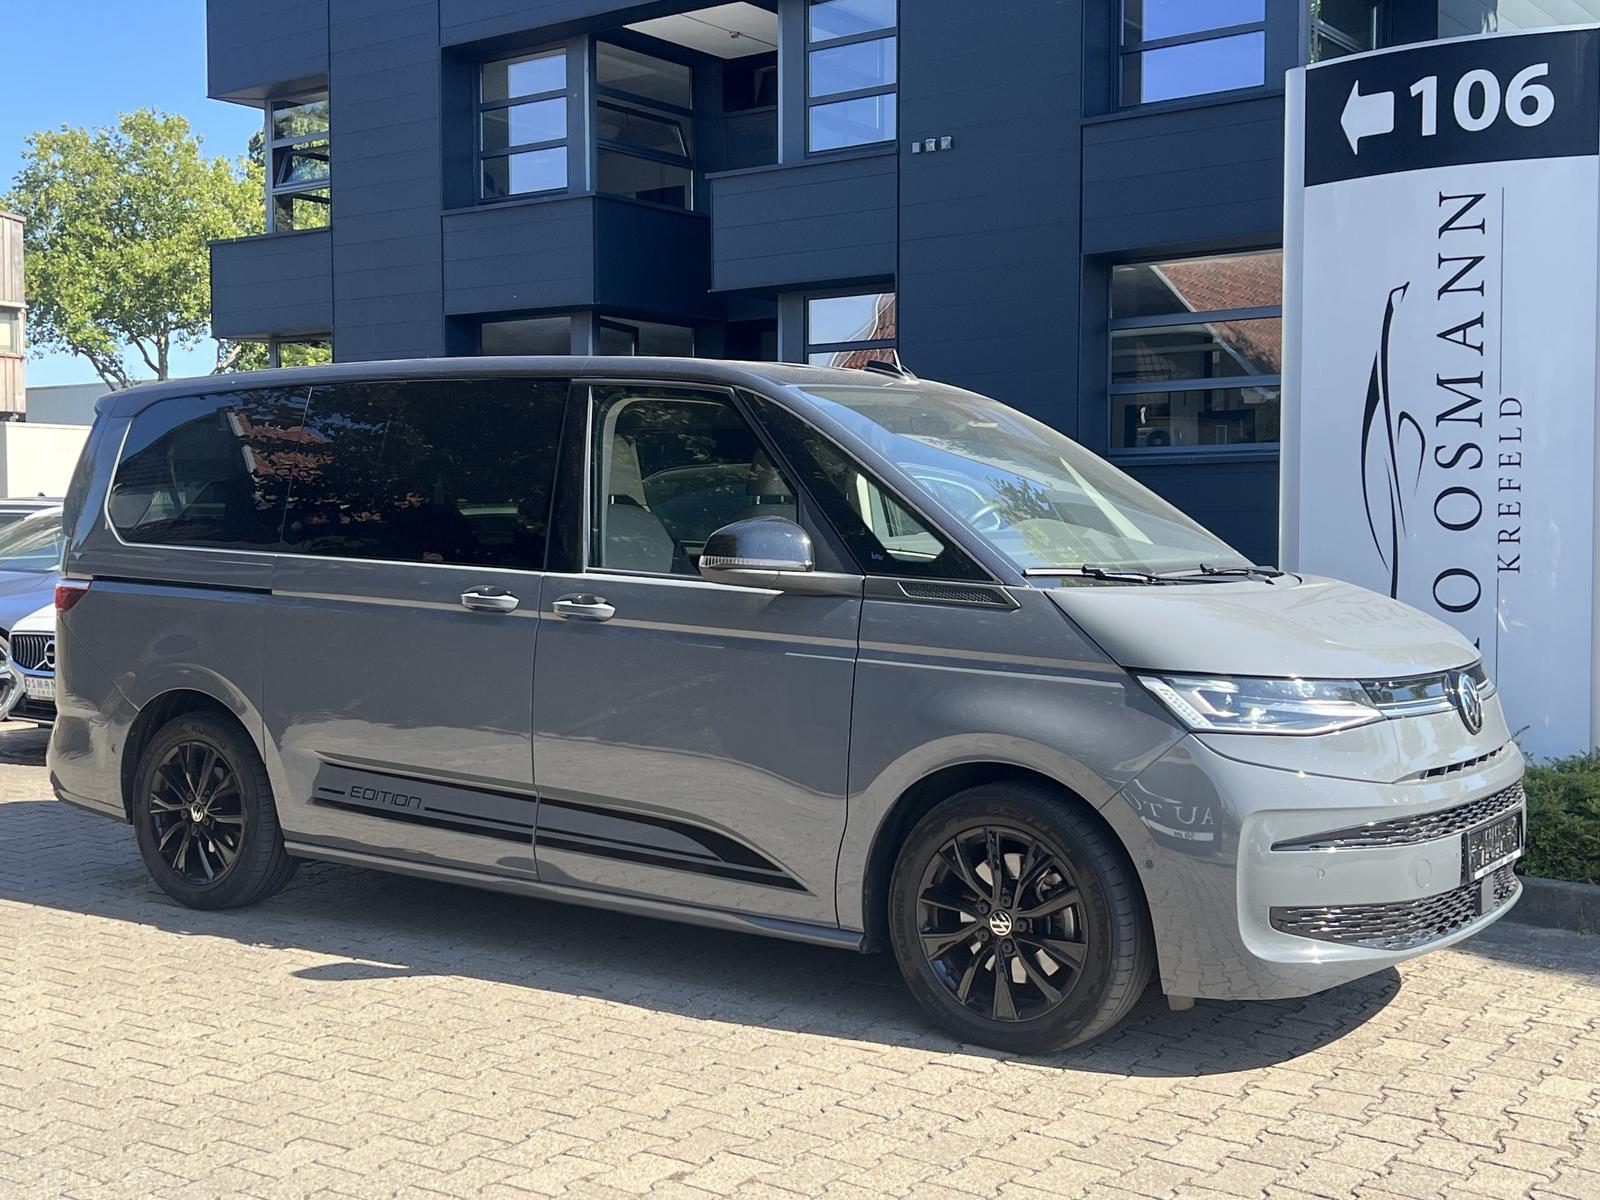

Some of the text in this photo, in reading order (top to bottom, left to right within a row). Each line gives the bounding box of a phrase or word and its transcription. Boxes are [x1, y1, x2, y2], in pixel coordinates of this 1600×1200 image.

[1409, 62, 1555, 136] 106
[1433, 191, 1486, 531] OSMANN
[1497, 397, 1522, 574] KREFELD
[350, 786, 422, 810] EDITION
